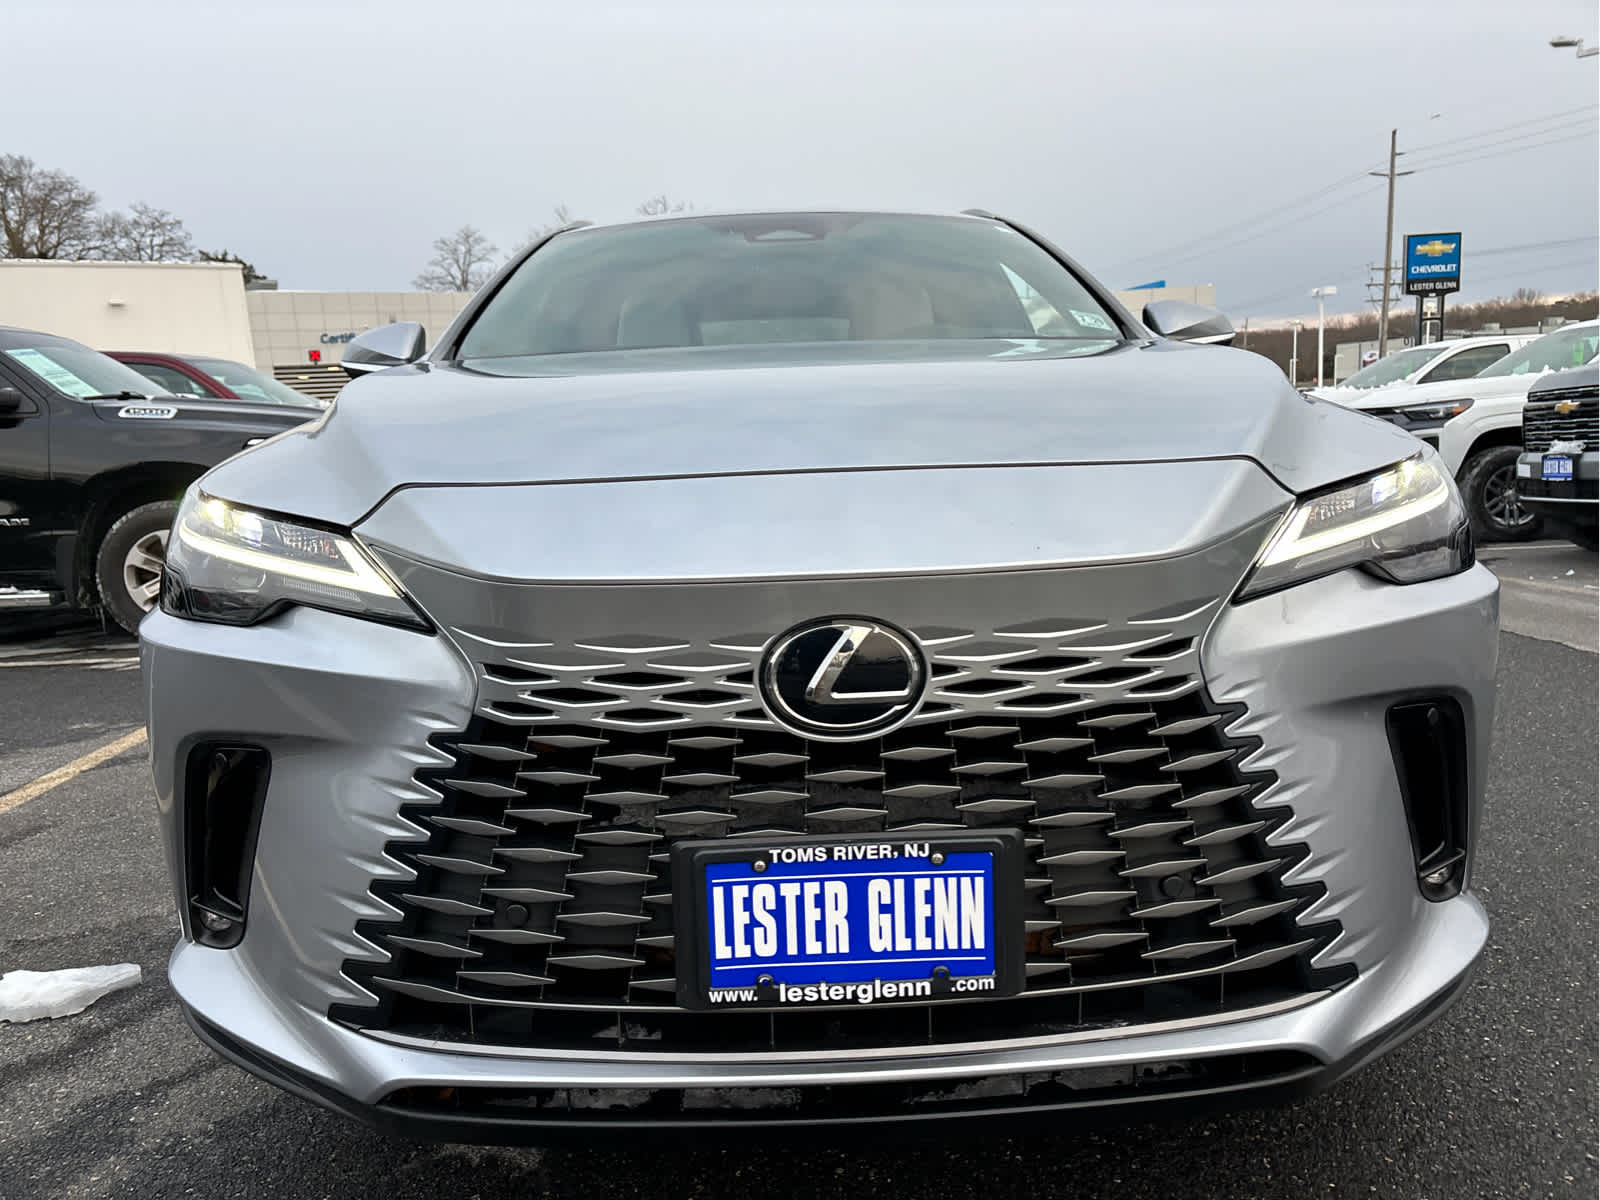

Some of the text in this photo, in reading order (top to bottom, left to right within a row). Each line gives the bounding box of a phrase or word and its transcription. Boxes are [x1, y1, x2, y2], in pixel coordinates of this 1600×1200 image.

[1411, 264, 1457, 274] CHEVROLET
[1410, 281, 1457, 291] LESTER GLENN
[769, 841, 931, 863] TOMS RIVER, NJ
[713, 876, 985, 960] LESTER GLENN
